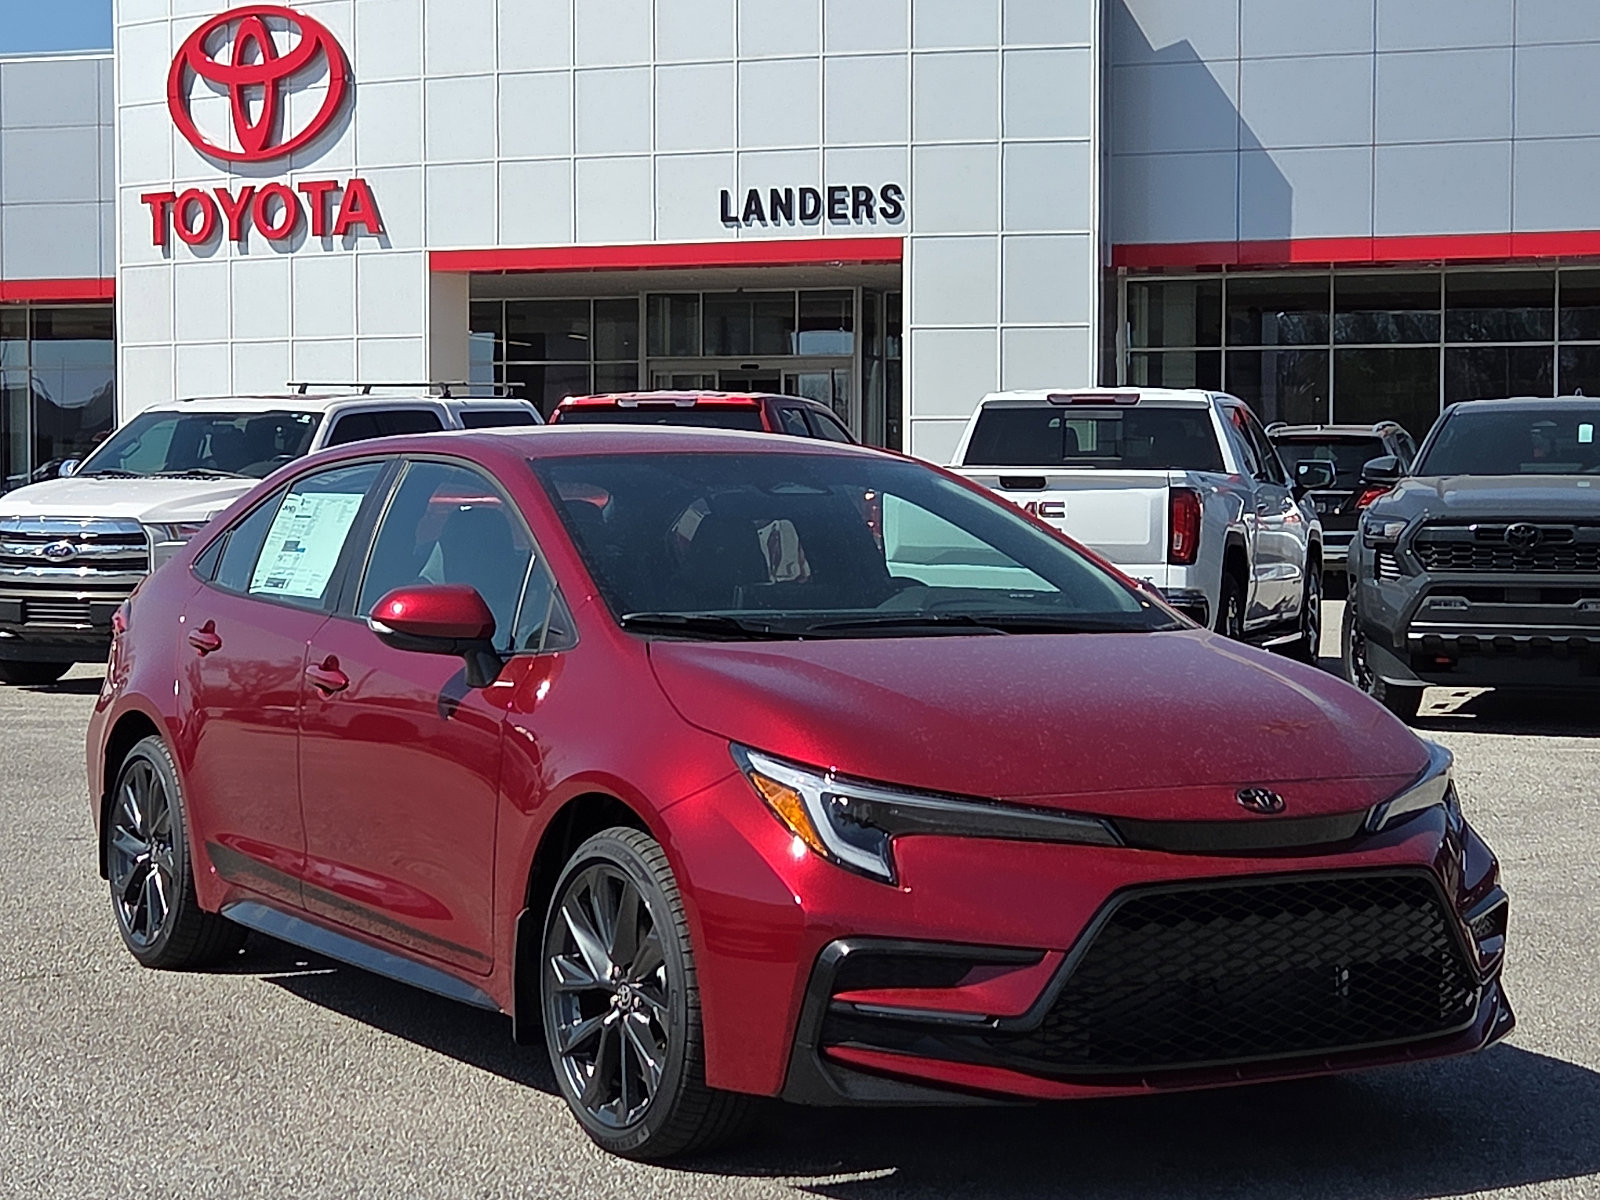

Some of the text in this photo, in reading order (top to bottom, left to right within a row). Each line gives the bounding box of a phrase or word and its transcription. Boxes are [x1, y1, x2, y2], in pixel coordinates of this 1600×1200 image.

[141, 178, 384, 247] TOYOTA
[720, 184, 903, 223] LANDERS
[1012, 501, 1066, 518] MC
